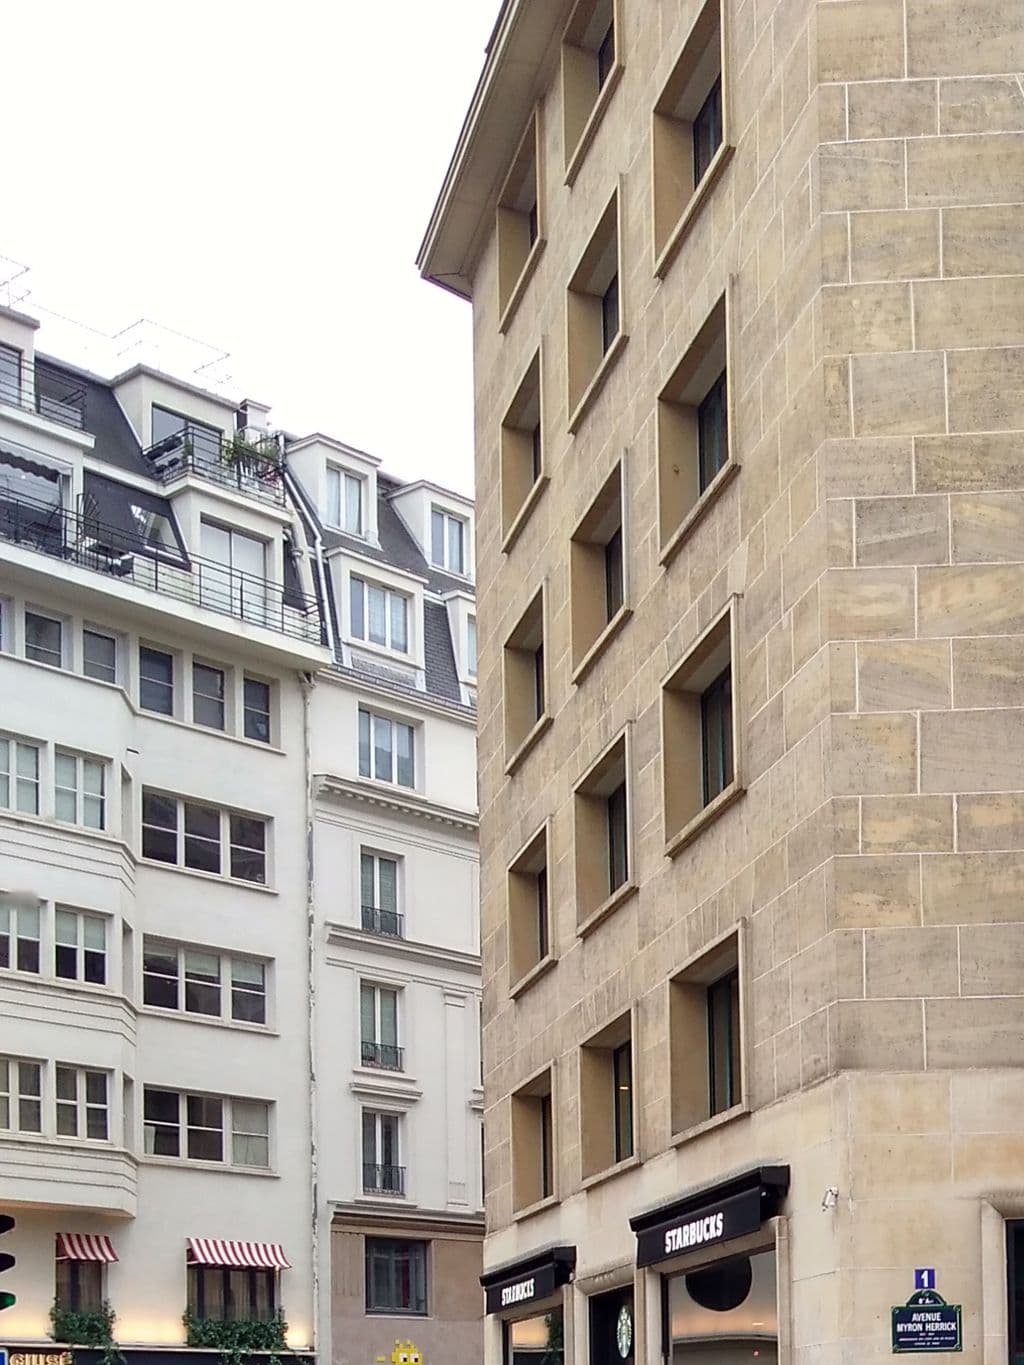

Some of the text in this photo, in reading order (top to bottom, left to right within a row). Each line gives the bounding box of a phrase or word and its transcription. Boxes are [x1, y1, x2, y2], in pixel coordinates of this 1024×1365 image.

[664, 1212, 724, 1254] STARBUCKS
[921, 1270, 929, 1288] 1
[501, 1277, 535, 1306] STARBUCKS
[911, 1312, 941, 1322] AVENUE
[896, 1322, 957, 1332] MYRON HERRICK
